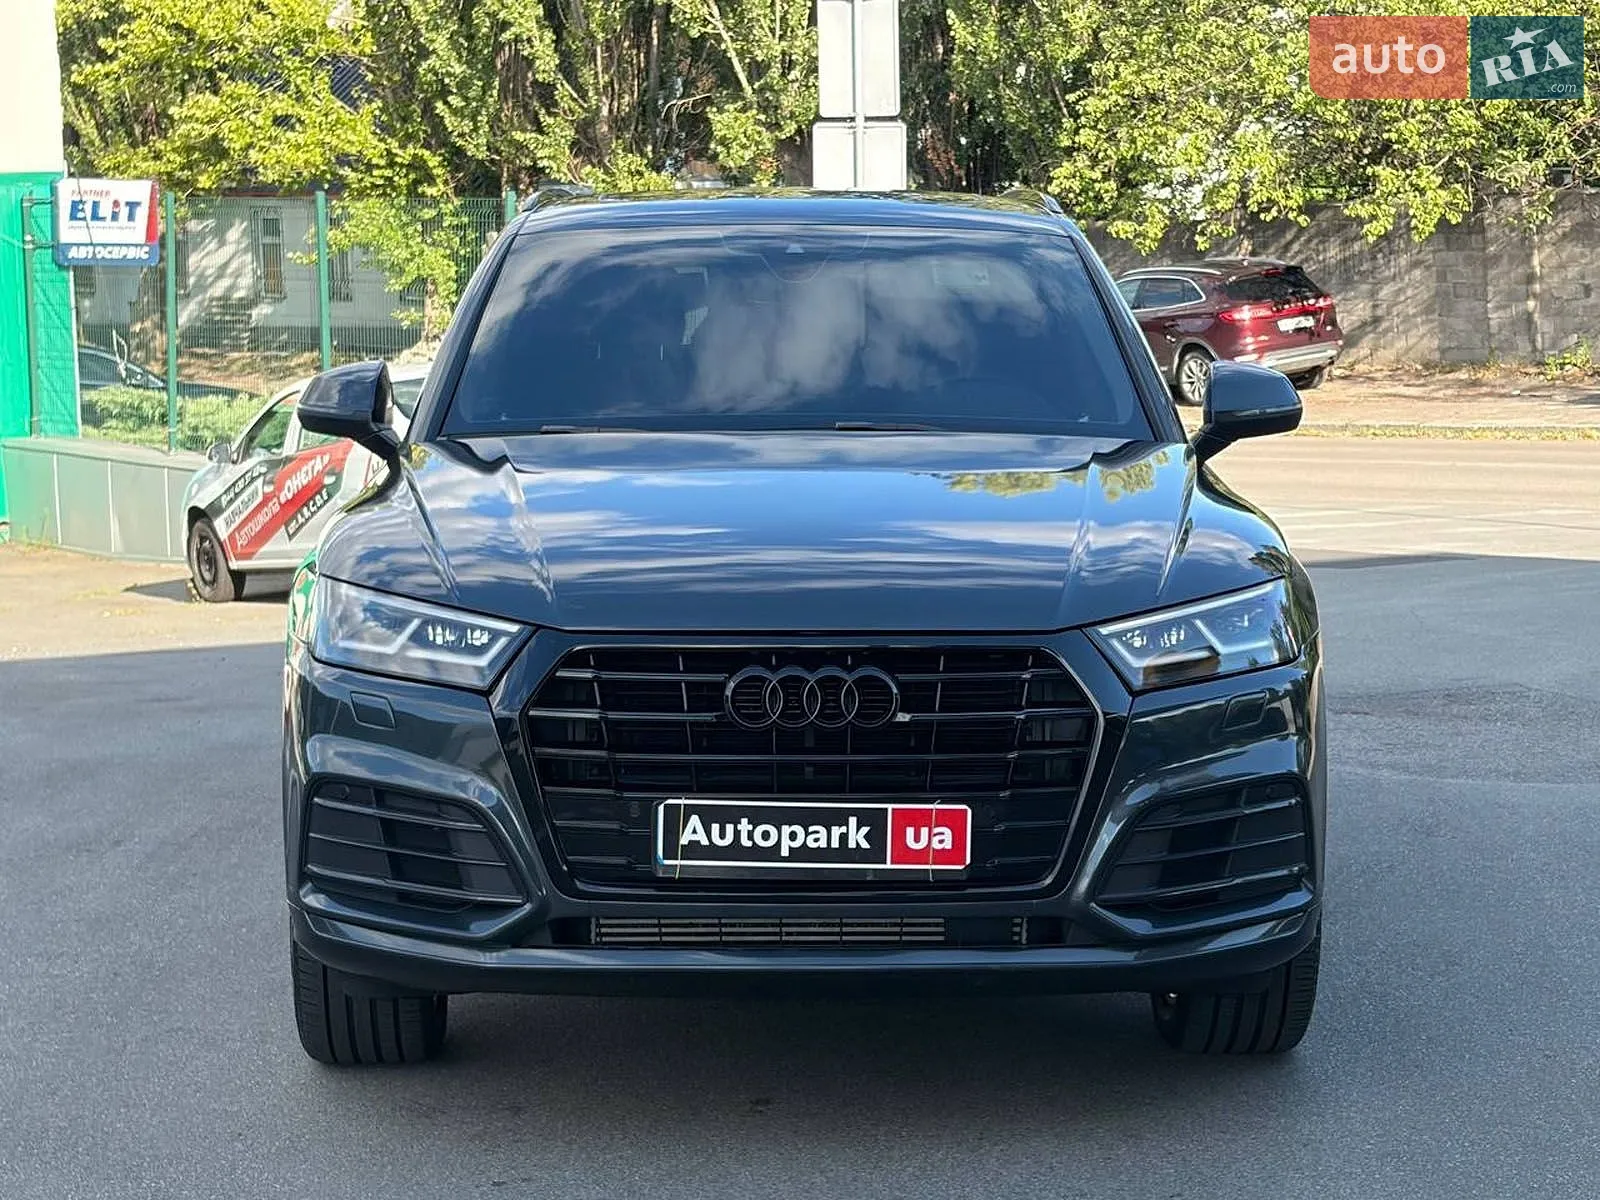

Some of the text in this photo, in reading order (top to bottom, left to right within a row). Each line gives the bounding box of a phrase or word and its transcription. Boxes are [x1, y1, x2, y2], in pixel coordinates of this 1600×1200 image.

[68, 246, 149, 259] АВТОСЕРВІС
[680, 814, 953, 856] Autopark ua
